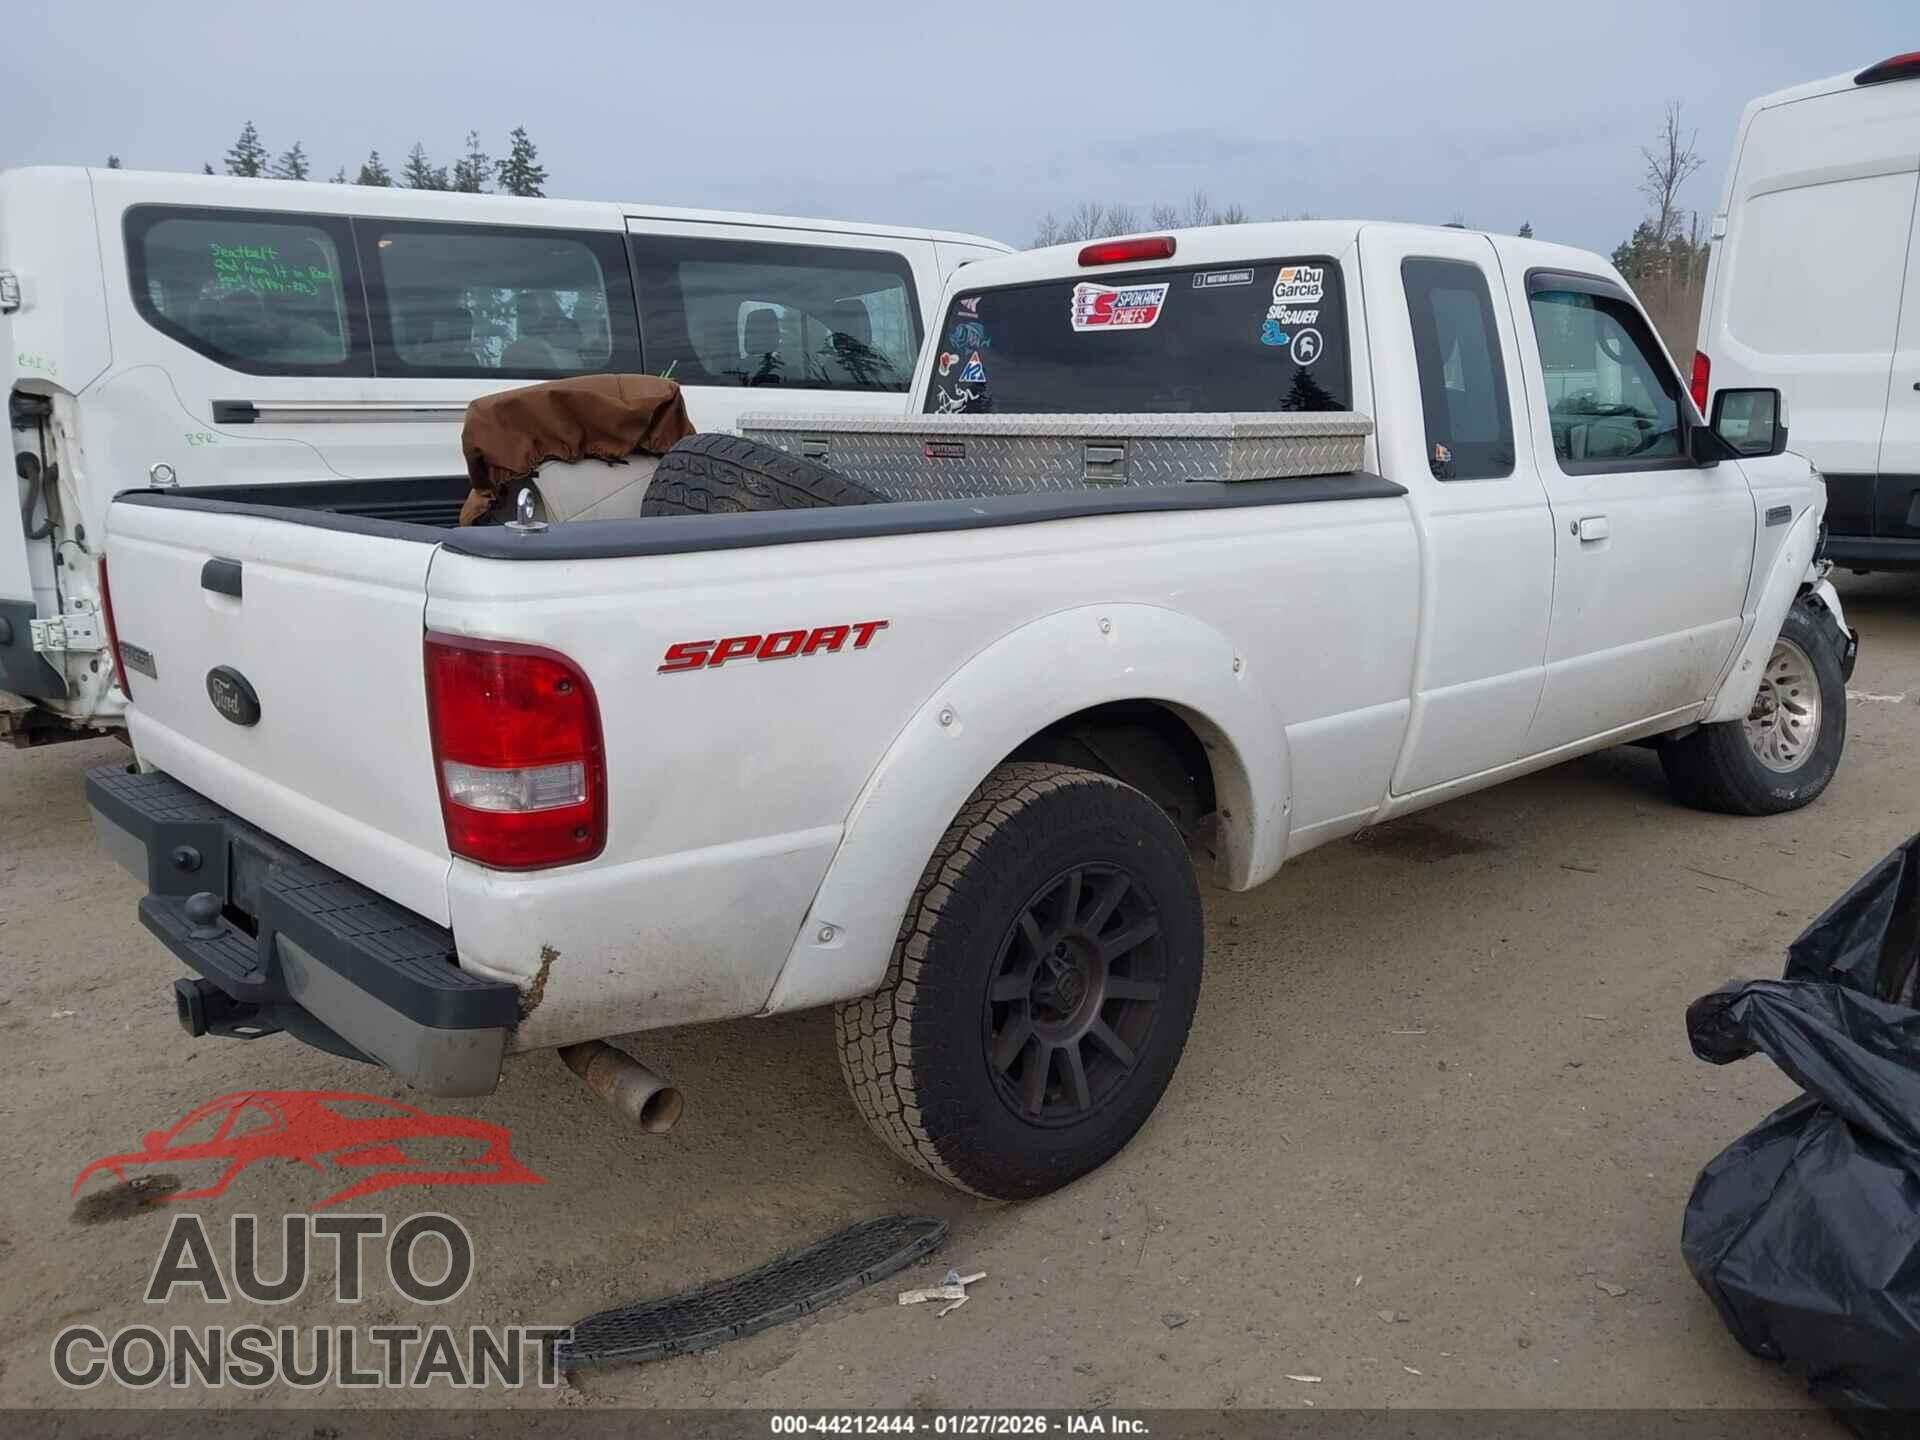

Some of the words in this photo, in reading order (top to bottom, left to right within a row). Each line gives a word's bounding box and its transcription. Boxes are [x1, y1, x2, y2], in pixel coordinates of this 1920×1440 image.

[1293, 268, 1320, 283] Abu
[1119, 289, 1164, 307] SPOKANE
[1112, 308, 1148, 324] CHIEFS
[1266, 305, 1287, 320] SIG
[1282, 310, 1320, 325] SAUER
[656, 619, 890, 675] SPORT
[212, 677, 240, 714] Ford
